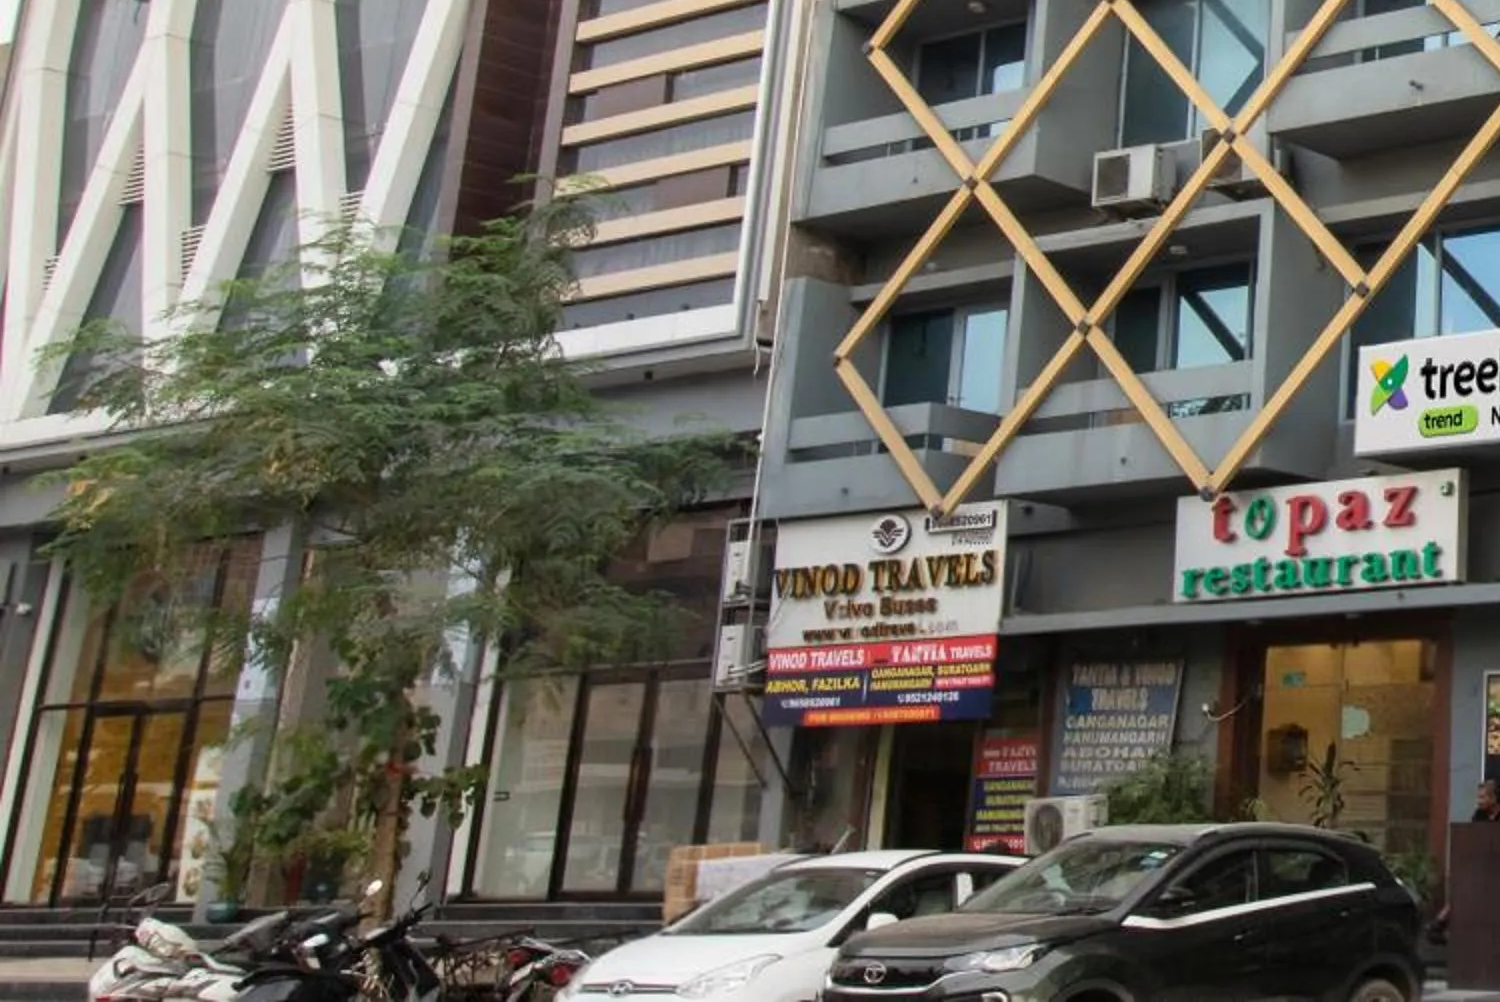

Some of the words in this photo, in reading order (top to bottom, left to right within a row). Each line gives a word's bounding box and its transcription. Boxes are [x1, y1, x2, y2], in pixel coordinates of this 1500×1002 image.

[1423, 409, 1464, 431] trend
[1211, 484, 1421, 557] topaz
[774, 562, 862, 599] VINOD
[867, 549, 998, 593] TRAVELS
[1180, 539, 1444, 599] restaurant
[769, 651, 808, 670] VINOD
[811, 648, 865, 668] TRAVELS
[951, 644, 993, 660] TRAVELS
[812, 676, 861, 692] FAZILKA
